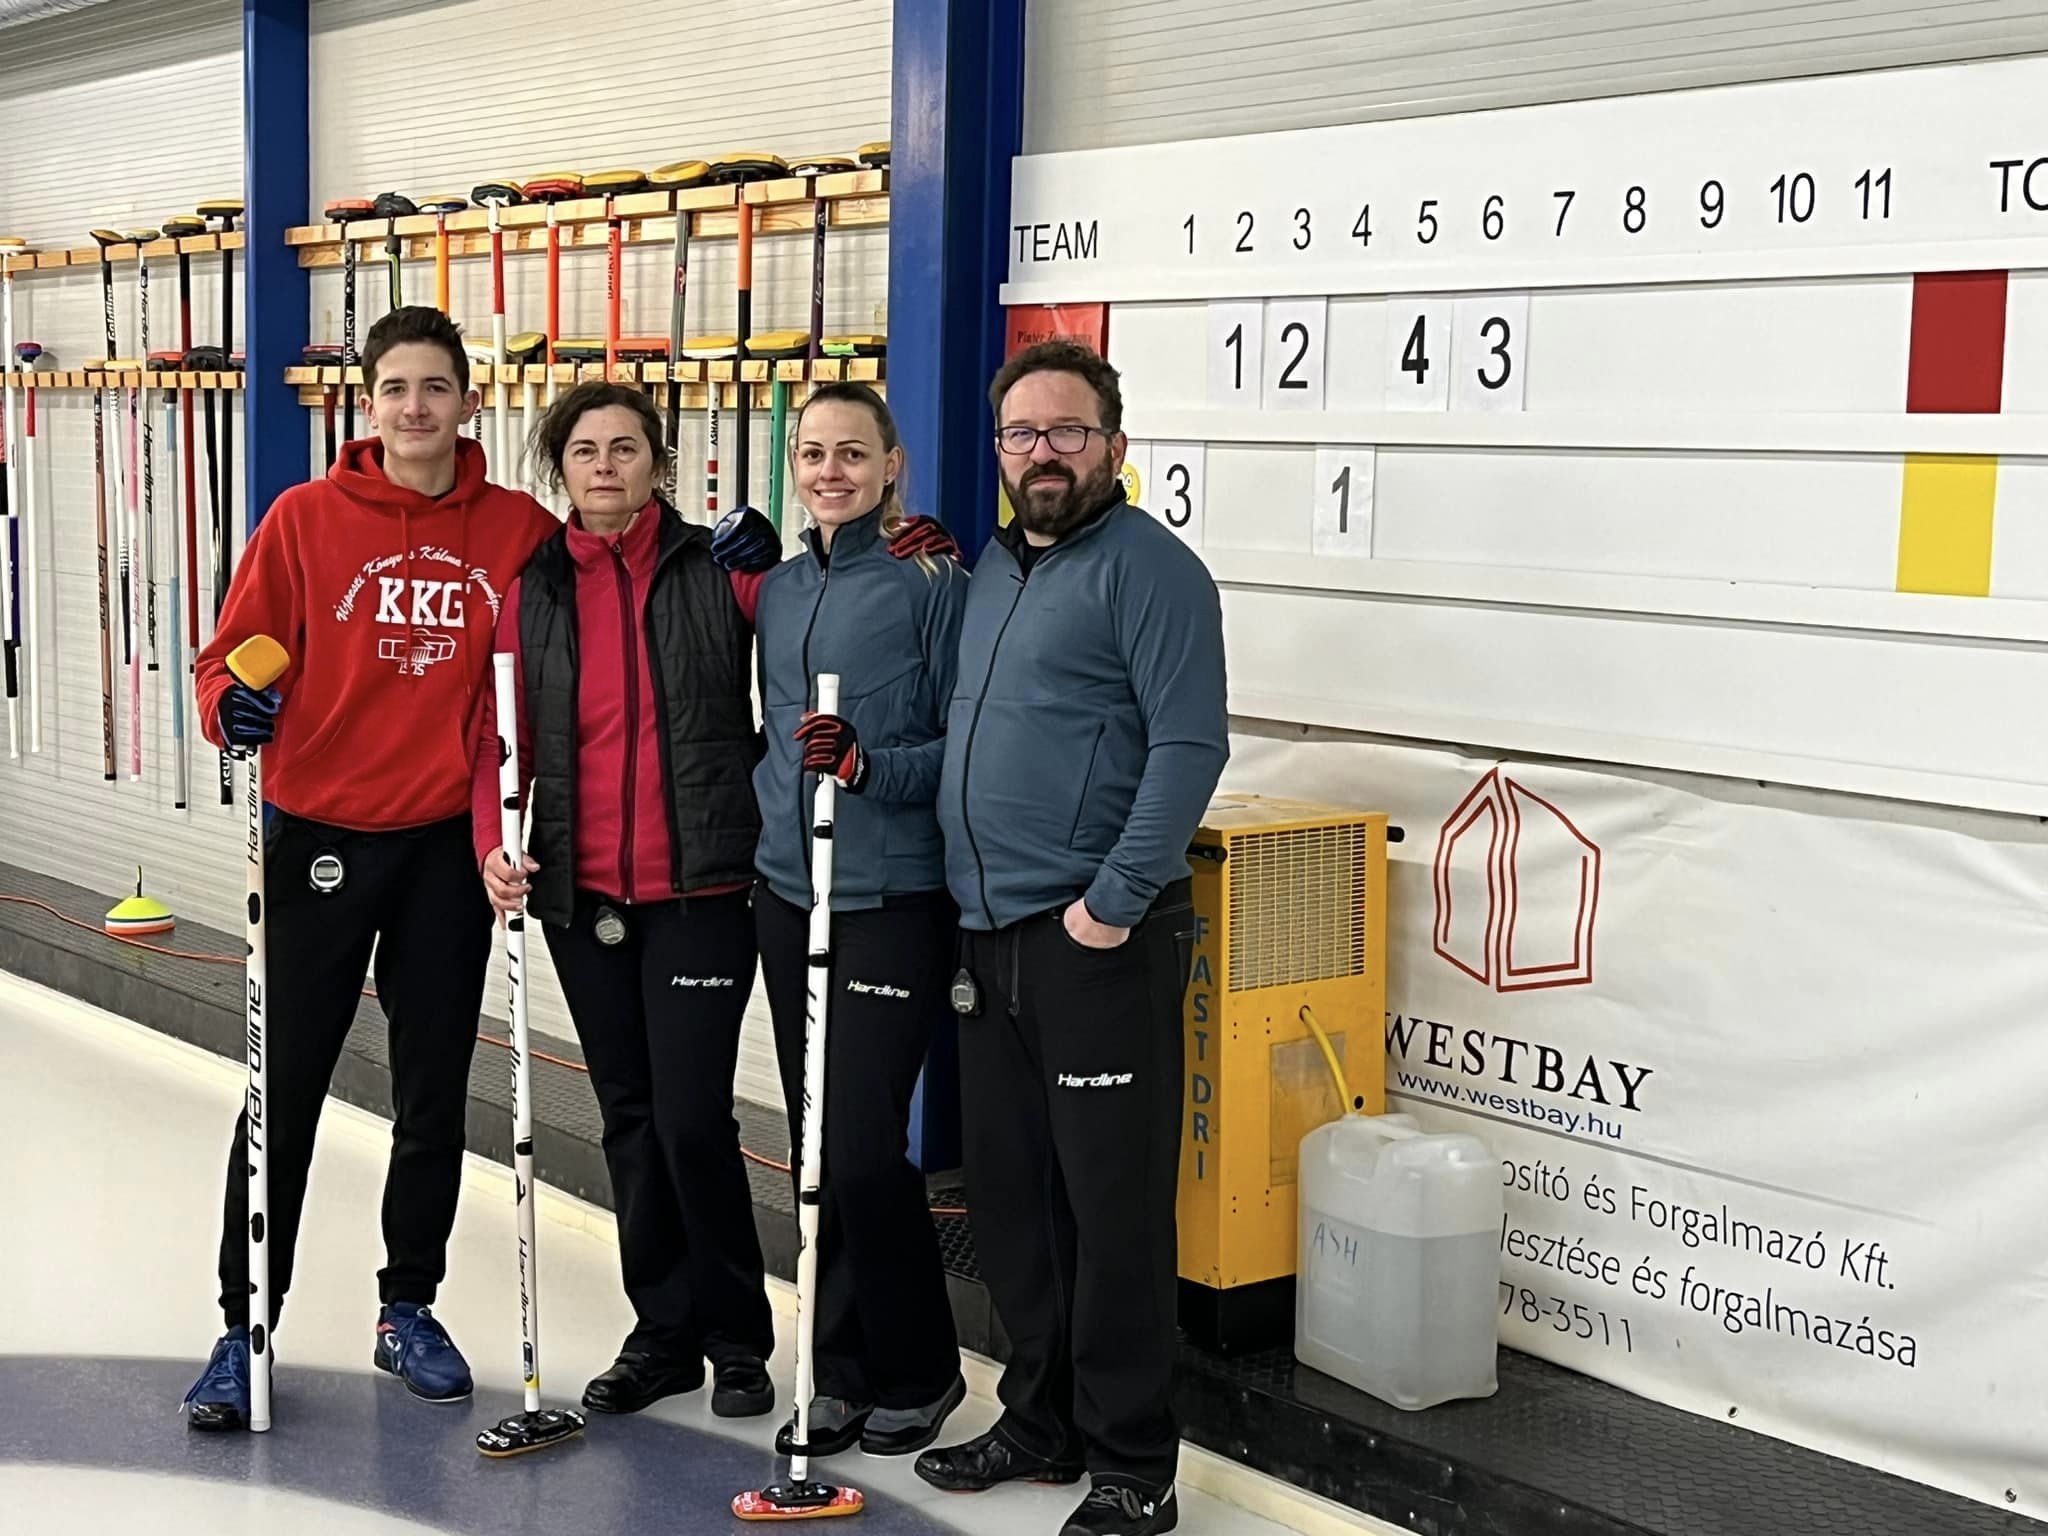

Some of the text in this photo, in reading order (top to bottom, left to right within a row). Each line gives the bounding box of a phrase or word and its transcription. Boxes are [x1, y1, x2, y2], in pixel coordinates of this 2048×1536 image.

[1013, 220, 1099, 263] TEAM
[1183, 214, 1196, 254] 1
[1235, 211, 1255, 253] 2
[1292, 207, 1312, 250] 3
[1351, 203, 1373, 247] 4
[1417, 200, 1438, 245] 5
[1482, 195, 1504, 240] 6
[1553, 190, 1576, 237] 7
[1622, 186, 1647, 234] 8
[1699, 180, 1725, 229] 9
[1769, 171, 1816, 224] 10
[1853, 167, 1893, 220] 11
[1224, 314, 1512, 391] 1 2 4 3
[1164, 463, 1352, 534] 3 1
[375, 576, 471, 628] KKG
[247, 761, 260, 865] Hardline
[847, 980, 910, 999] Hardline
[1057, 1072, 1133, 1088] Hardline
[1192, 916, 1213, 1181] FAST DRI
[1385, 1011, 1654, 1112] WESTBAY
[1397, 1071, 1622, 1140] www.westbay.hu
[1583, 1173, 1617, 1215] és
[1631, 1185, 1827, 1270] Forgalmazó
[1839, 1237, 1896, 1290] Kft.
[1631, 1255, 1669, 1300] és
[1680, 1265, 1917, 1368] forgalmazása
